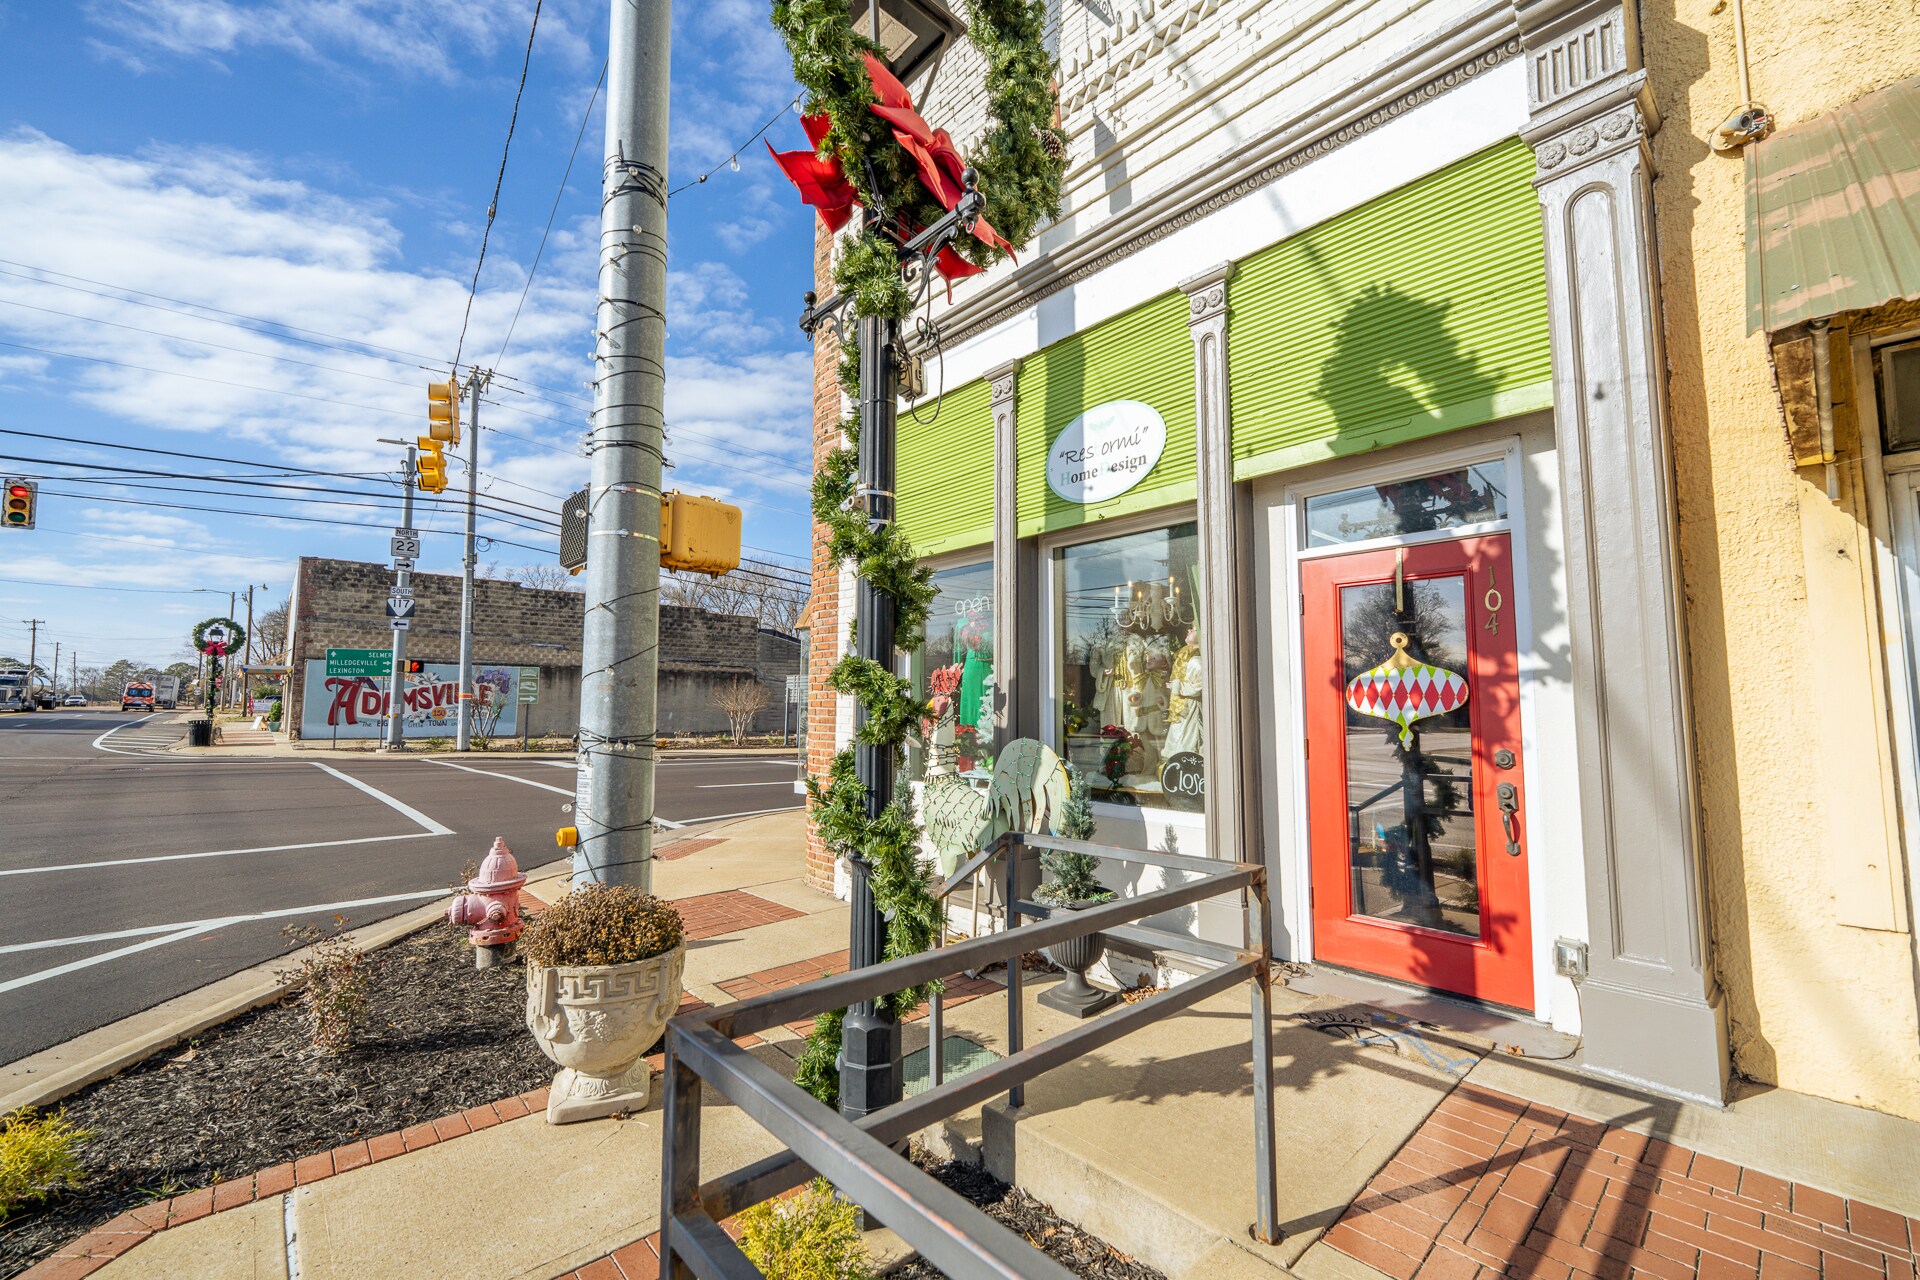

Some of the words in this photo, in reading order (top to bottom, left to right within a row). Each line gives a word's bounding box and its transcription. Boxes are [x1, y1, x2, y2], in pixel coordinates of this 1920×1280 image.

[1060, 467, 1098, 486] Home
[1100, 454, 1147, 473] Design
[396, 529, 418, 537] NORTH
[396, 541, 415, 552] 22
[391, 587, 412, 595] SOUTH
[393, 600, 409, 608] 117
[1485, 565, 1502, 636] 104
[955, 596, 990, 618] open
